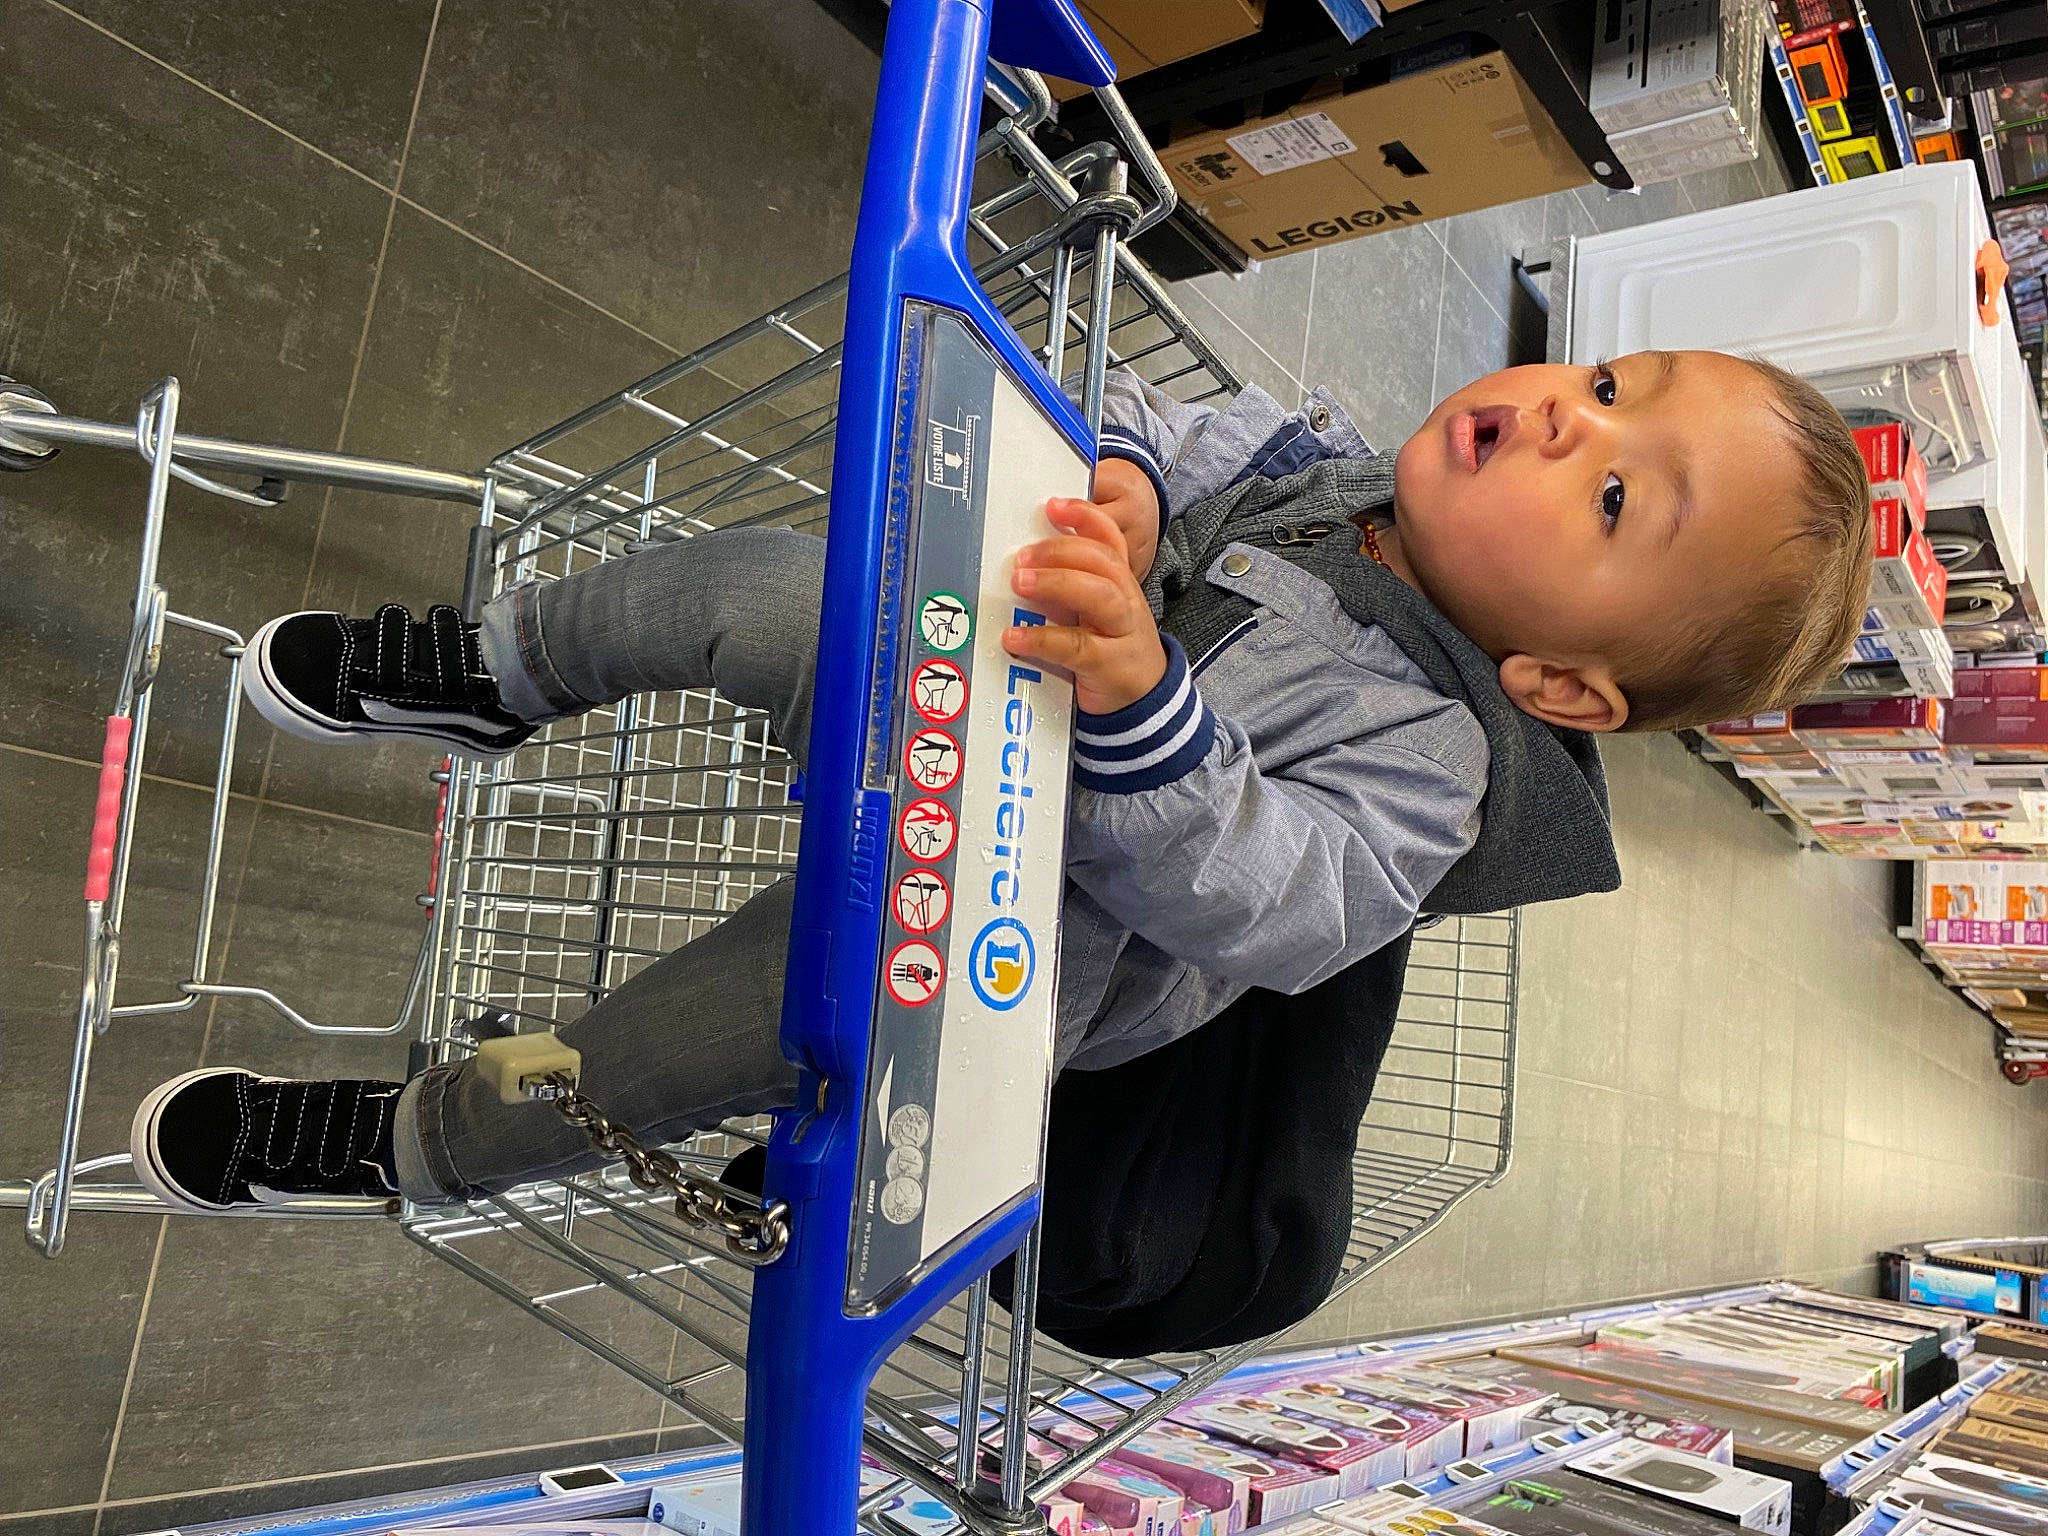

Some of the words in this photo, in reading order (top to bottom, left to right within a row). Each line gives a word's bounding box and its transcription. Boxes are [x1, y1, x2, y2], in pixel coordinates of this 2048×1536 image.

[1250, 200, 1423, 254] LEGION
[932, 427, 944, 457] VOTRE
[932, 457, 944, 484] LISTE
[990, 664, 1042, 907] Leclerc
[847, 806, 879, 914] wanzl
[984, 940, 1022, 979] L
[866, 1180, 876, 1214] wanzl
